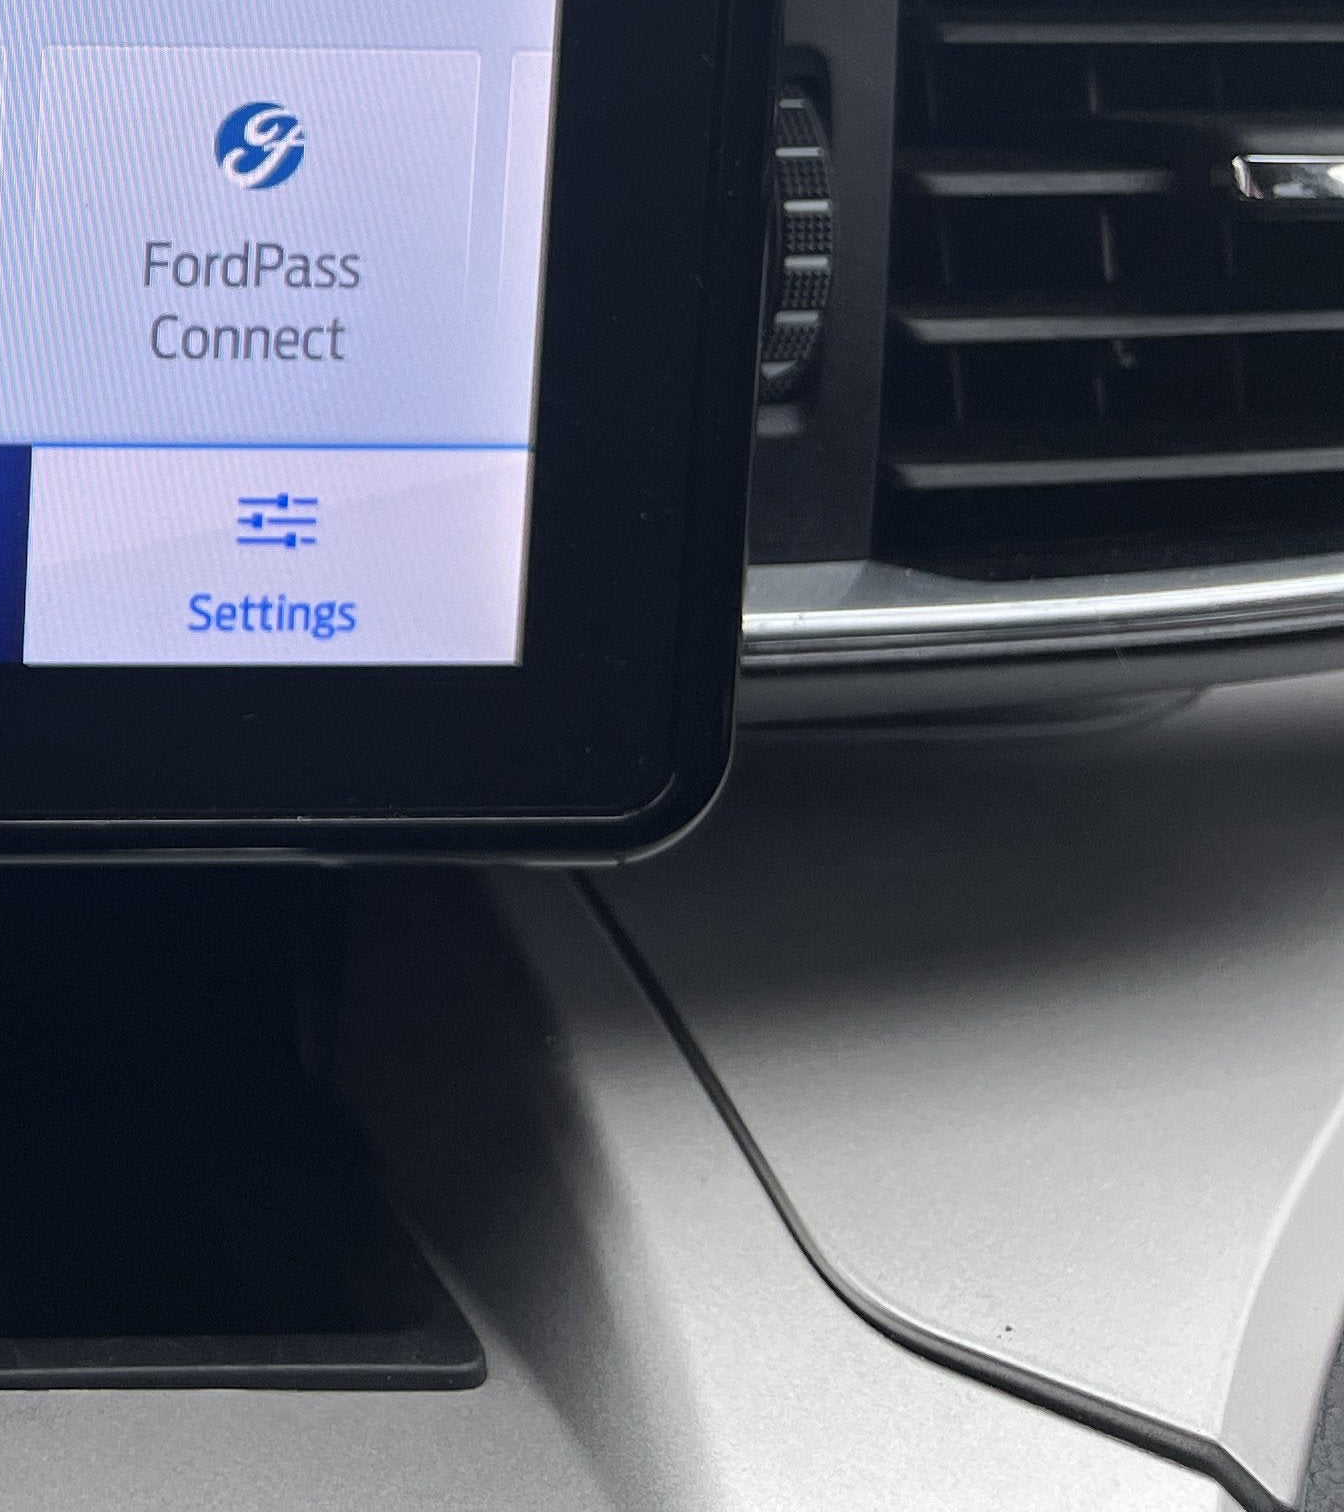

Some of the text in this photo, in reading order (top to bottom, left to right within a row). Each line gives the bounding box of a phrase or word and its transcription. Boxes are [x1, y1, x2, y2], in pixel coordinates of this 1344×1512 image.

[143, 241, 361, 291] FordPass
[149, 313, 346, 363] Connect
[187, 592, 358, 638] Settings
